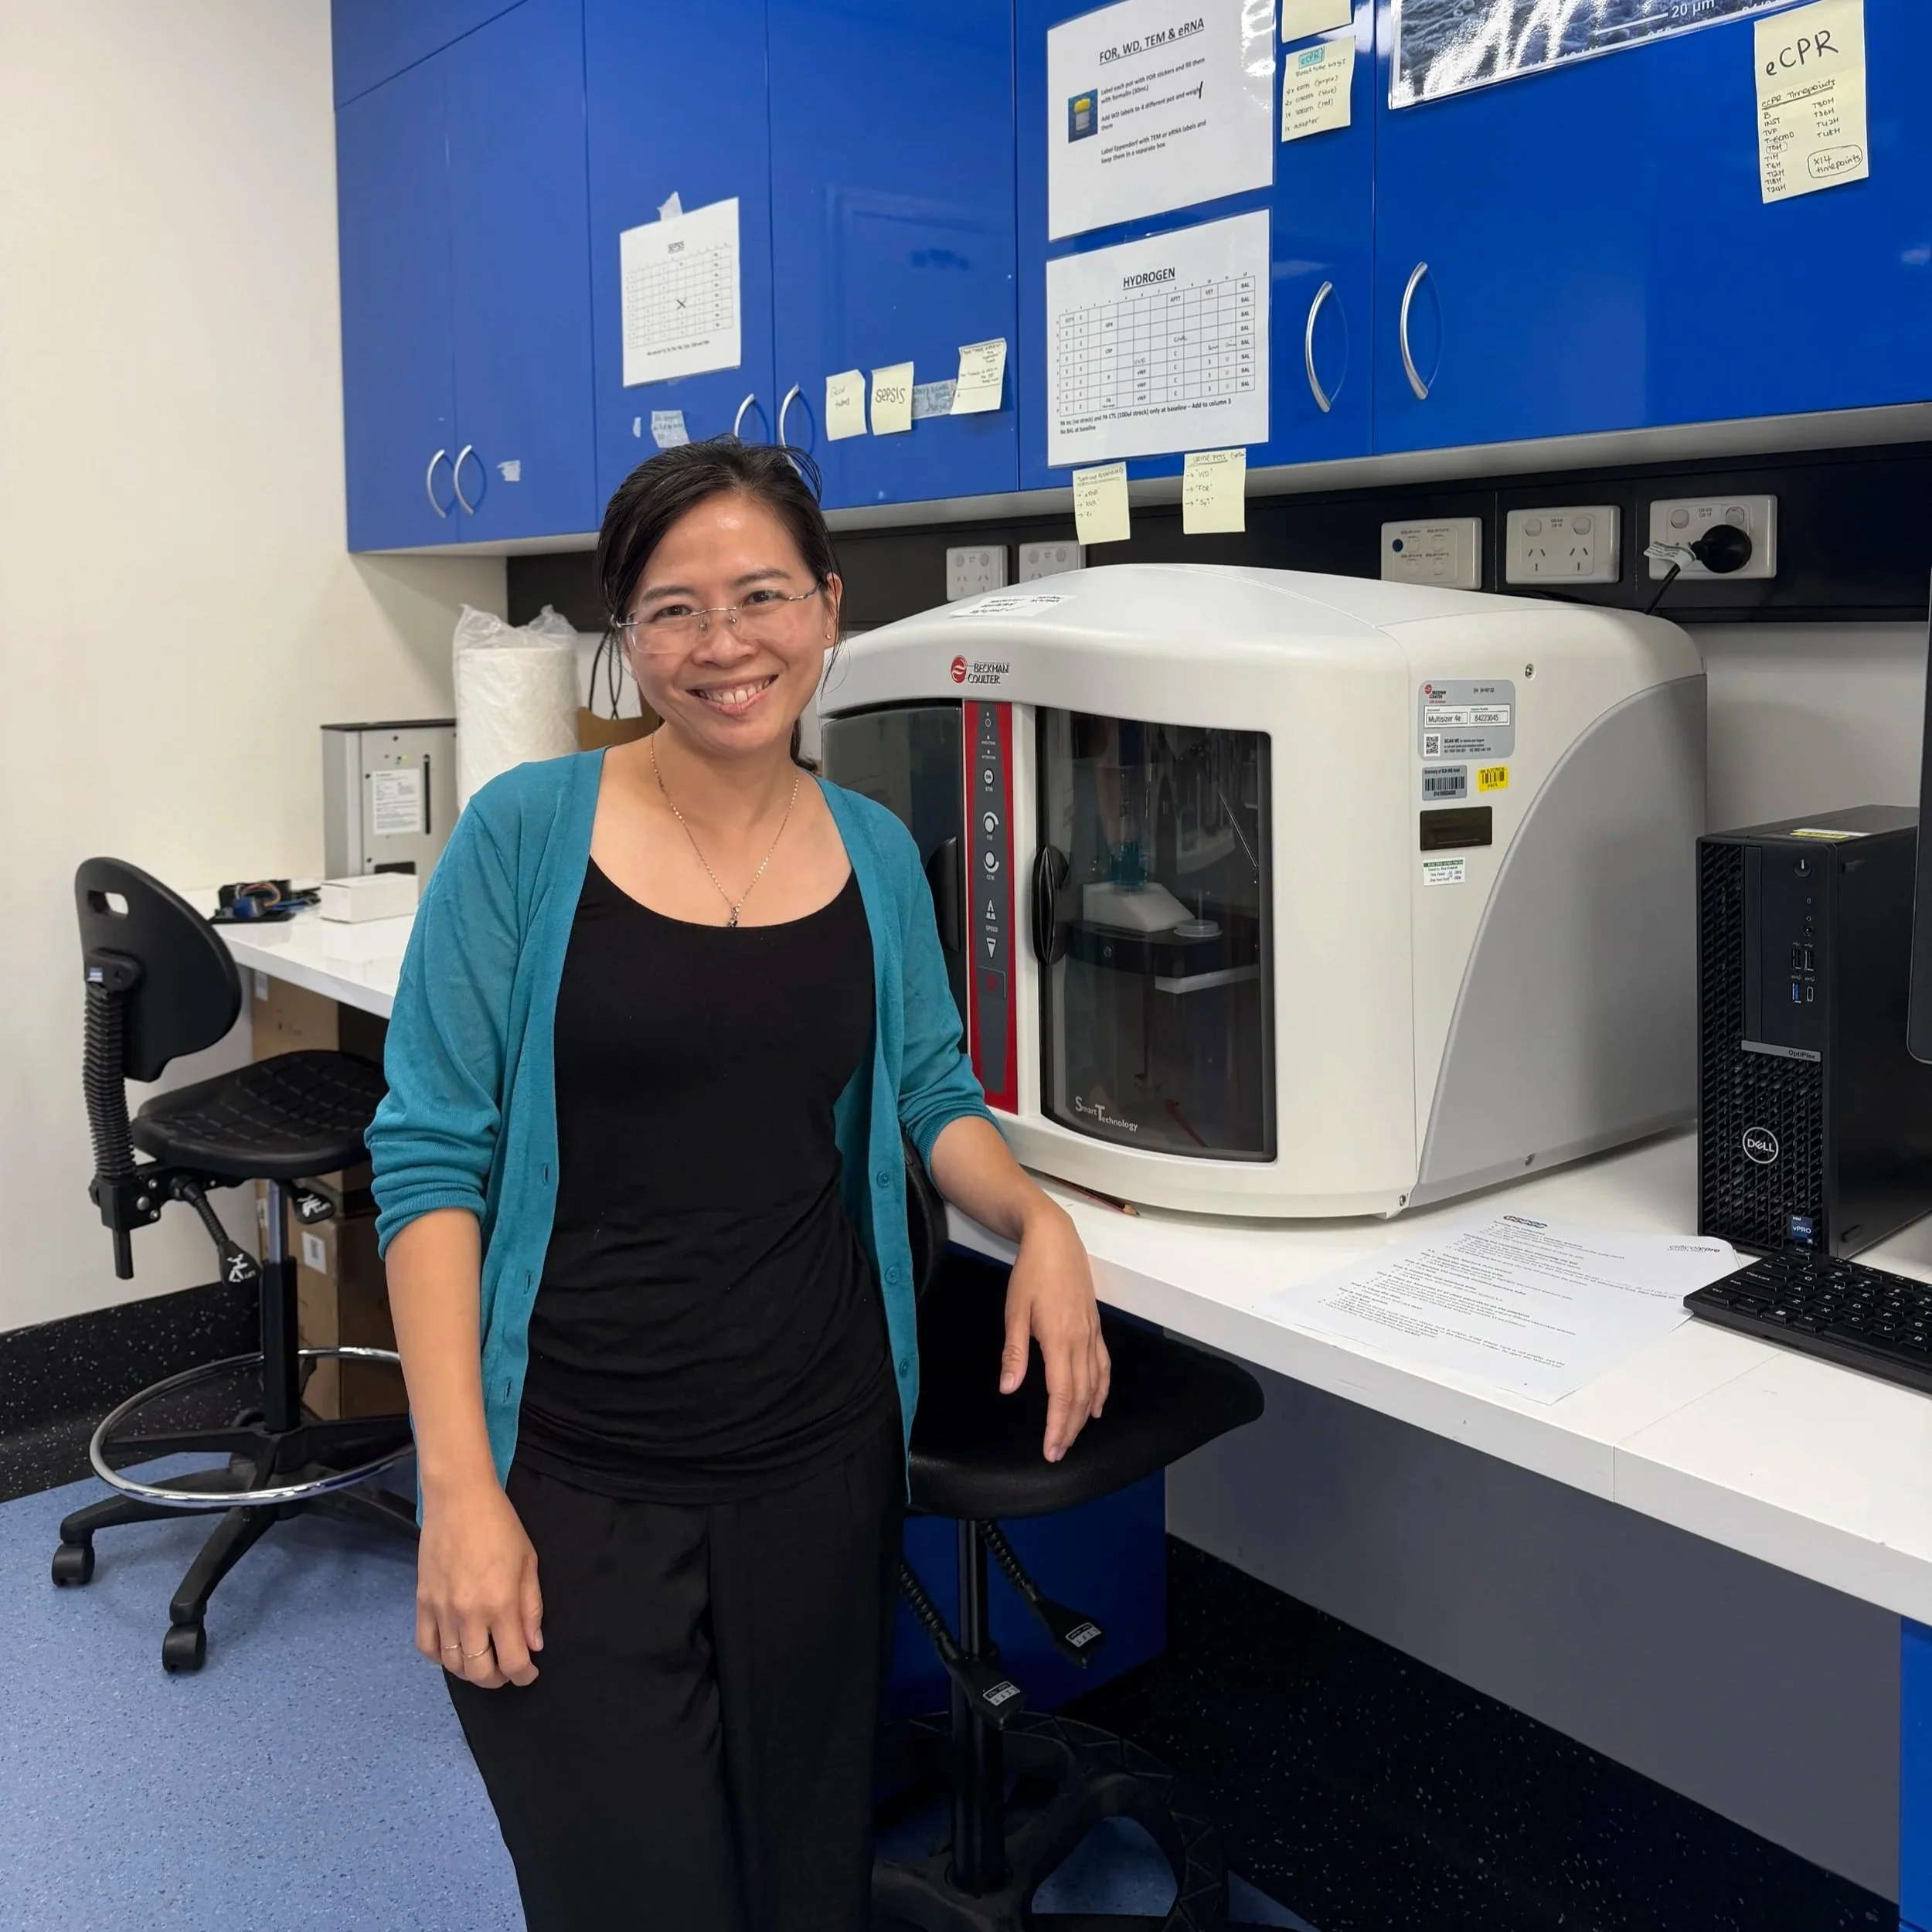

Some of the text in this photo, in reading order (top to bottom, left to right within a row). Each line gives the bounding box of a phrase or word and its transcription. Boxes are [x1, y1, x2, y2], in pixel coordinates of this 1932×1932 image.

[1672, 4, 1688, 19] 20
[1099, 18, 1204, 63] FOR, WD, TEM & eRNA
[1766, 30, 1839, 76] eCPR
[1100, 87, 1113, 96] Label
[1114, 83, 1124, 92] each
[1125, 80, 1134, 88] pot
[1134, 76, 1145, 84] with
[1146, 73, 1156, 81] FOR
[1157, 68, 1174, 78] stickers
[1175, 63, 1184, 73] and
[1192, 57, 1205, 66] them
[1100, 114, 1111, 122] Add
[1120, 108, 1134, 117] labels
[1145, 99, 1165, 109] different
[1175, 91, 1185, 100] and
[1814, 107, 1835, 117] T36H
[1100, 123, 1113, 131] them
[1294, 117, 1320, 129] adapter
[1764, 117, 1781, 127] INST
[1100, 147, 1113, 155] Label
[1114, 140, 1138, 152] Eppendorf
[1150, 133, 1162, 141] TEM
[1168, 128, 1182, 136] eRNA
[1182, 123, 1196, 132] labels
[1197, 119, 1206, 128] and
[1135, 145, 1155, 155] separate
[1817, 154, 1861, 173] timepoints
[1123, 267, 1175, 288] HYDROGEN
[1133, 408, 1149, 417] streck)
[974, 662, 1009, 674] BECKMAN
[1788, 1049, 1815, 1059] OptiPlex
[1747, 1138, 1775, 1152] DELL
[1792, 1226, 1811, 1234] vPRO
